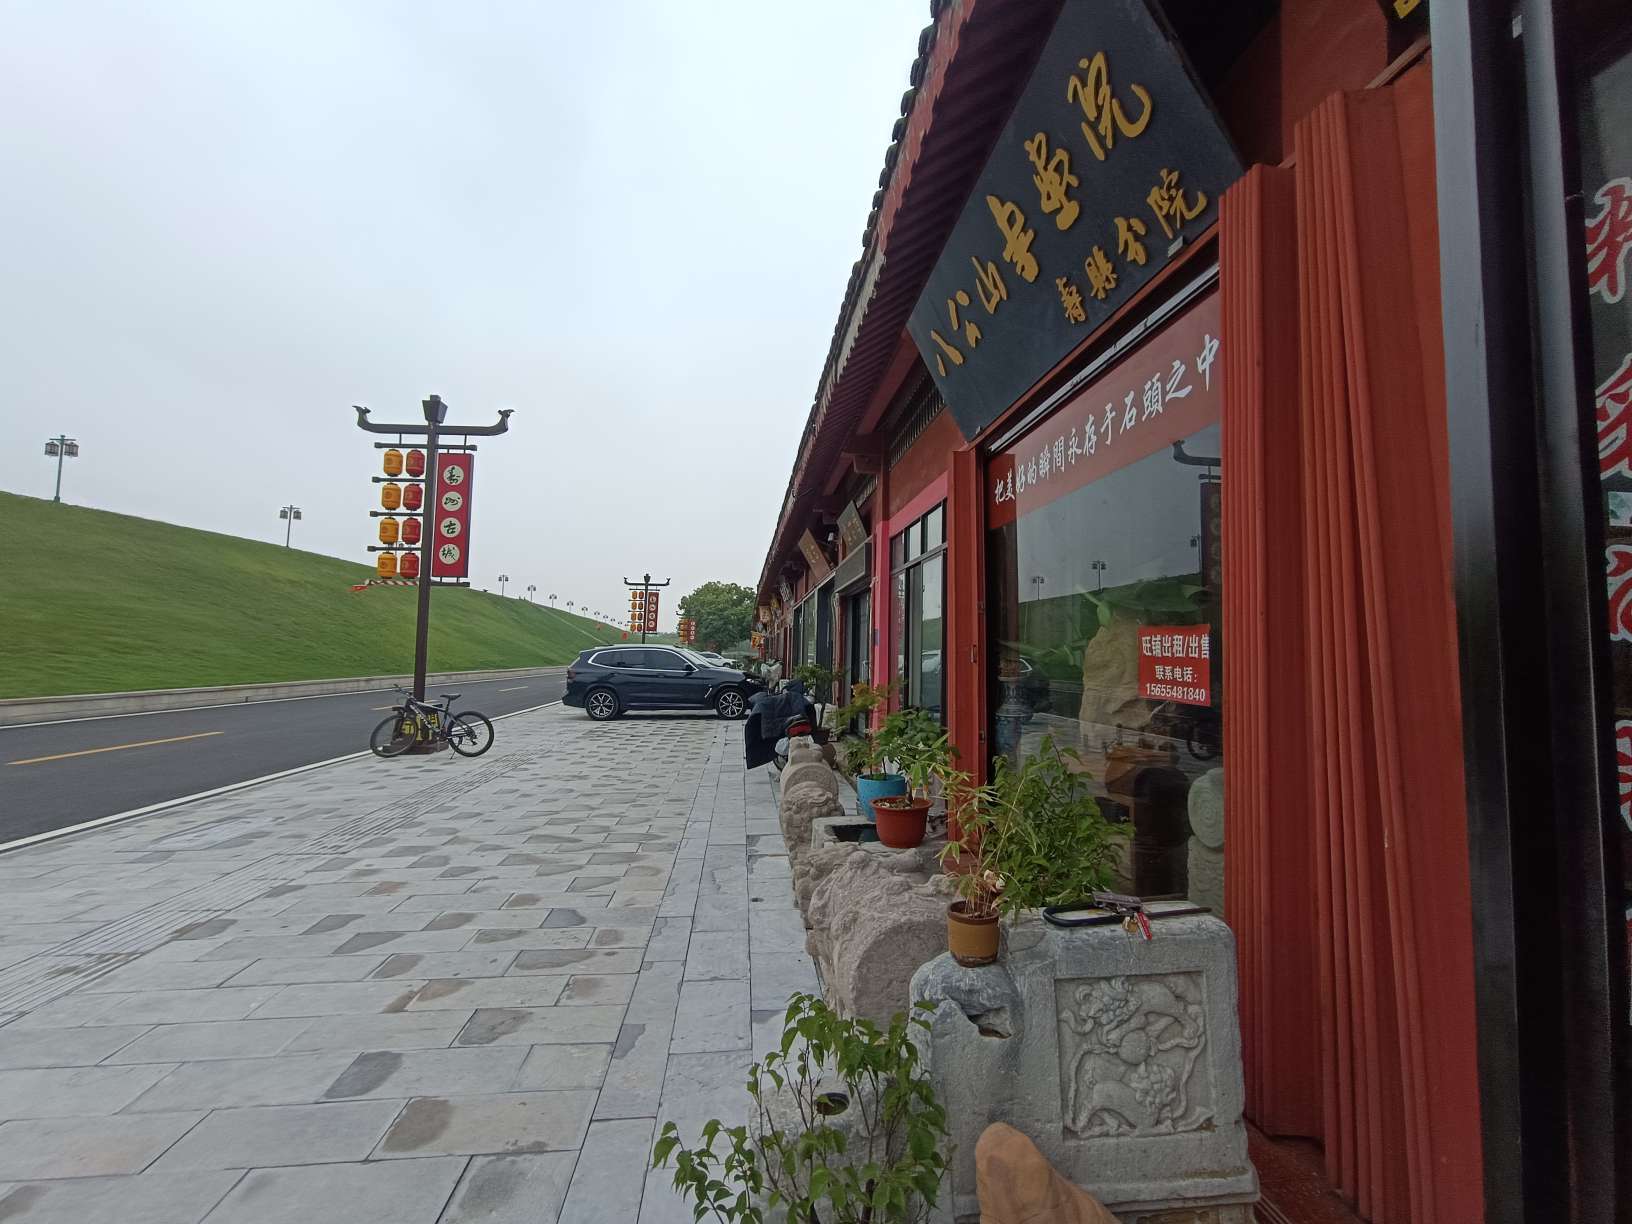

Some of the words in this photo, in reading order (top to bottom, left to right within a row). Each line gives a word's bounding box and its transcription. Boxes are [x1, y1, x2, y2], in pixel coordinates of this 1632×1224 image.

[1142, 634, 1210, 660] 旺铺出租/出售
[1145, 683, 1206, 702] 15655481840
